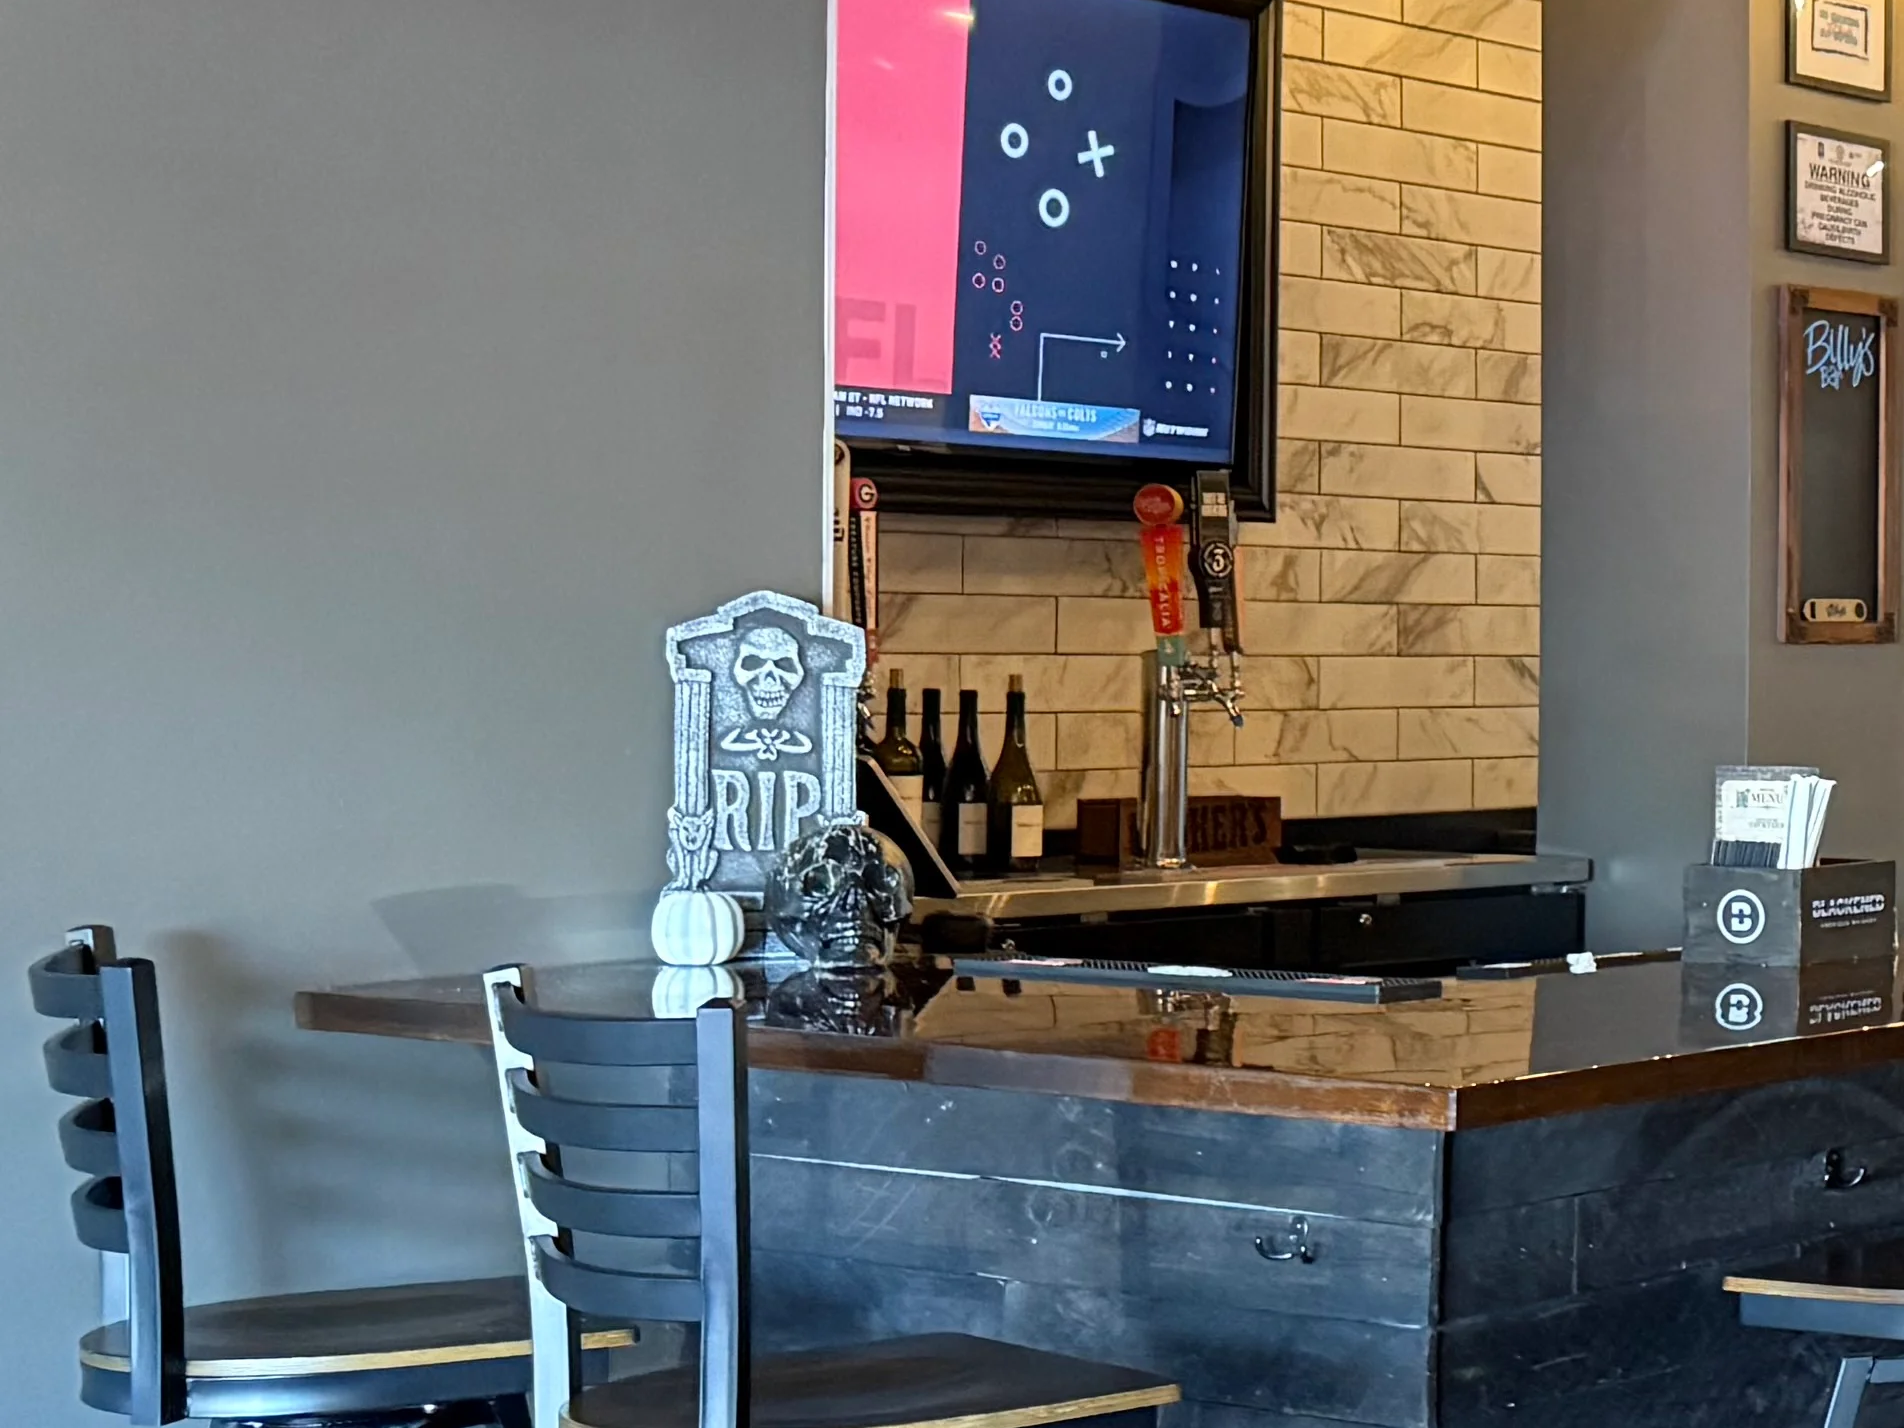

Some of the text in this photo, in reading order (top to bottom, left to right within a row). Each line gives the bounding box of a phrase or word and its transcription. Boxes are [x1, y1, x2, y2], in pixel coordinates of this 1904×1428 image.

[1809, 162, 1871, 189] WARNING
[1803, 319, 1875, 388] Billy's
[1067, 407, 1097, 423] COLTS
[858, 483, 876, 503] G
[1752, 792, 1784, 804] MENU
[711, 769, 822, 853] RIP
[1812, 894, 1885, 918] BLACKENED
